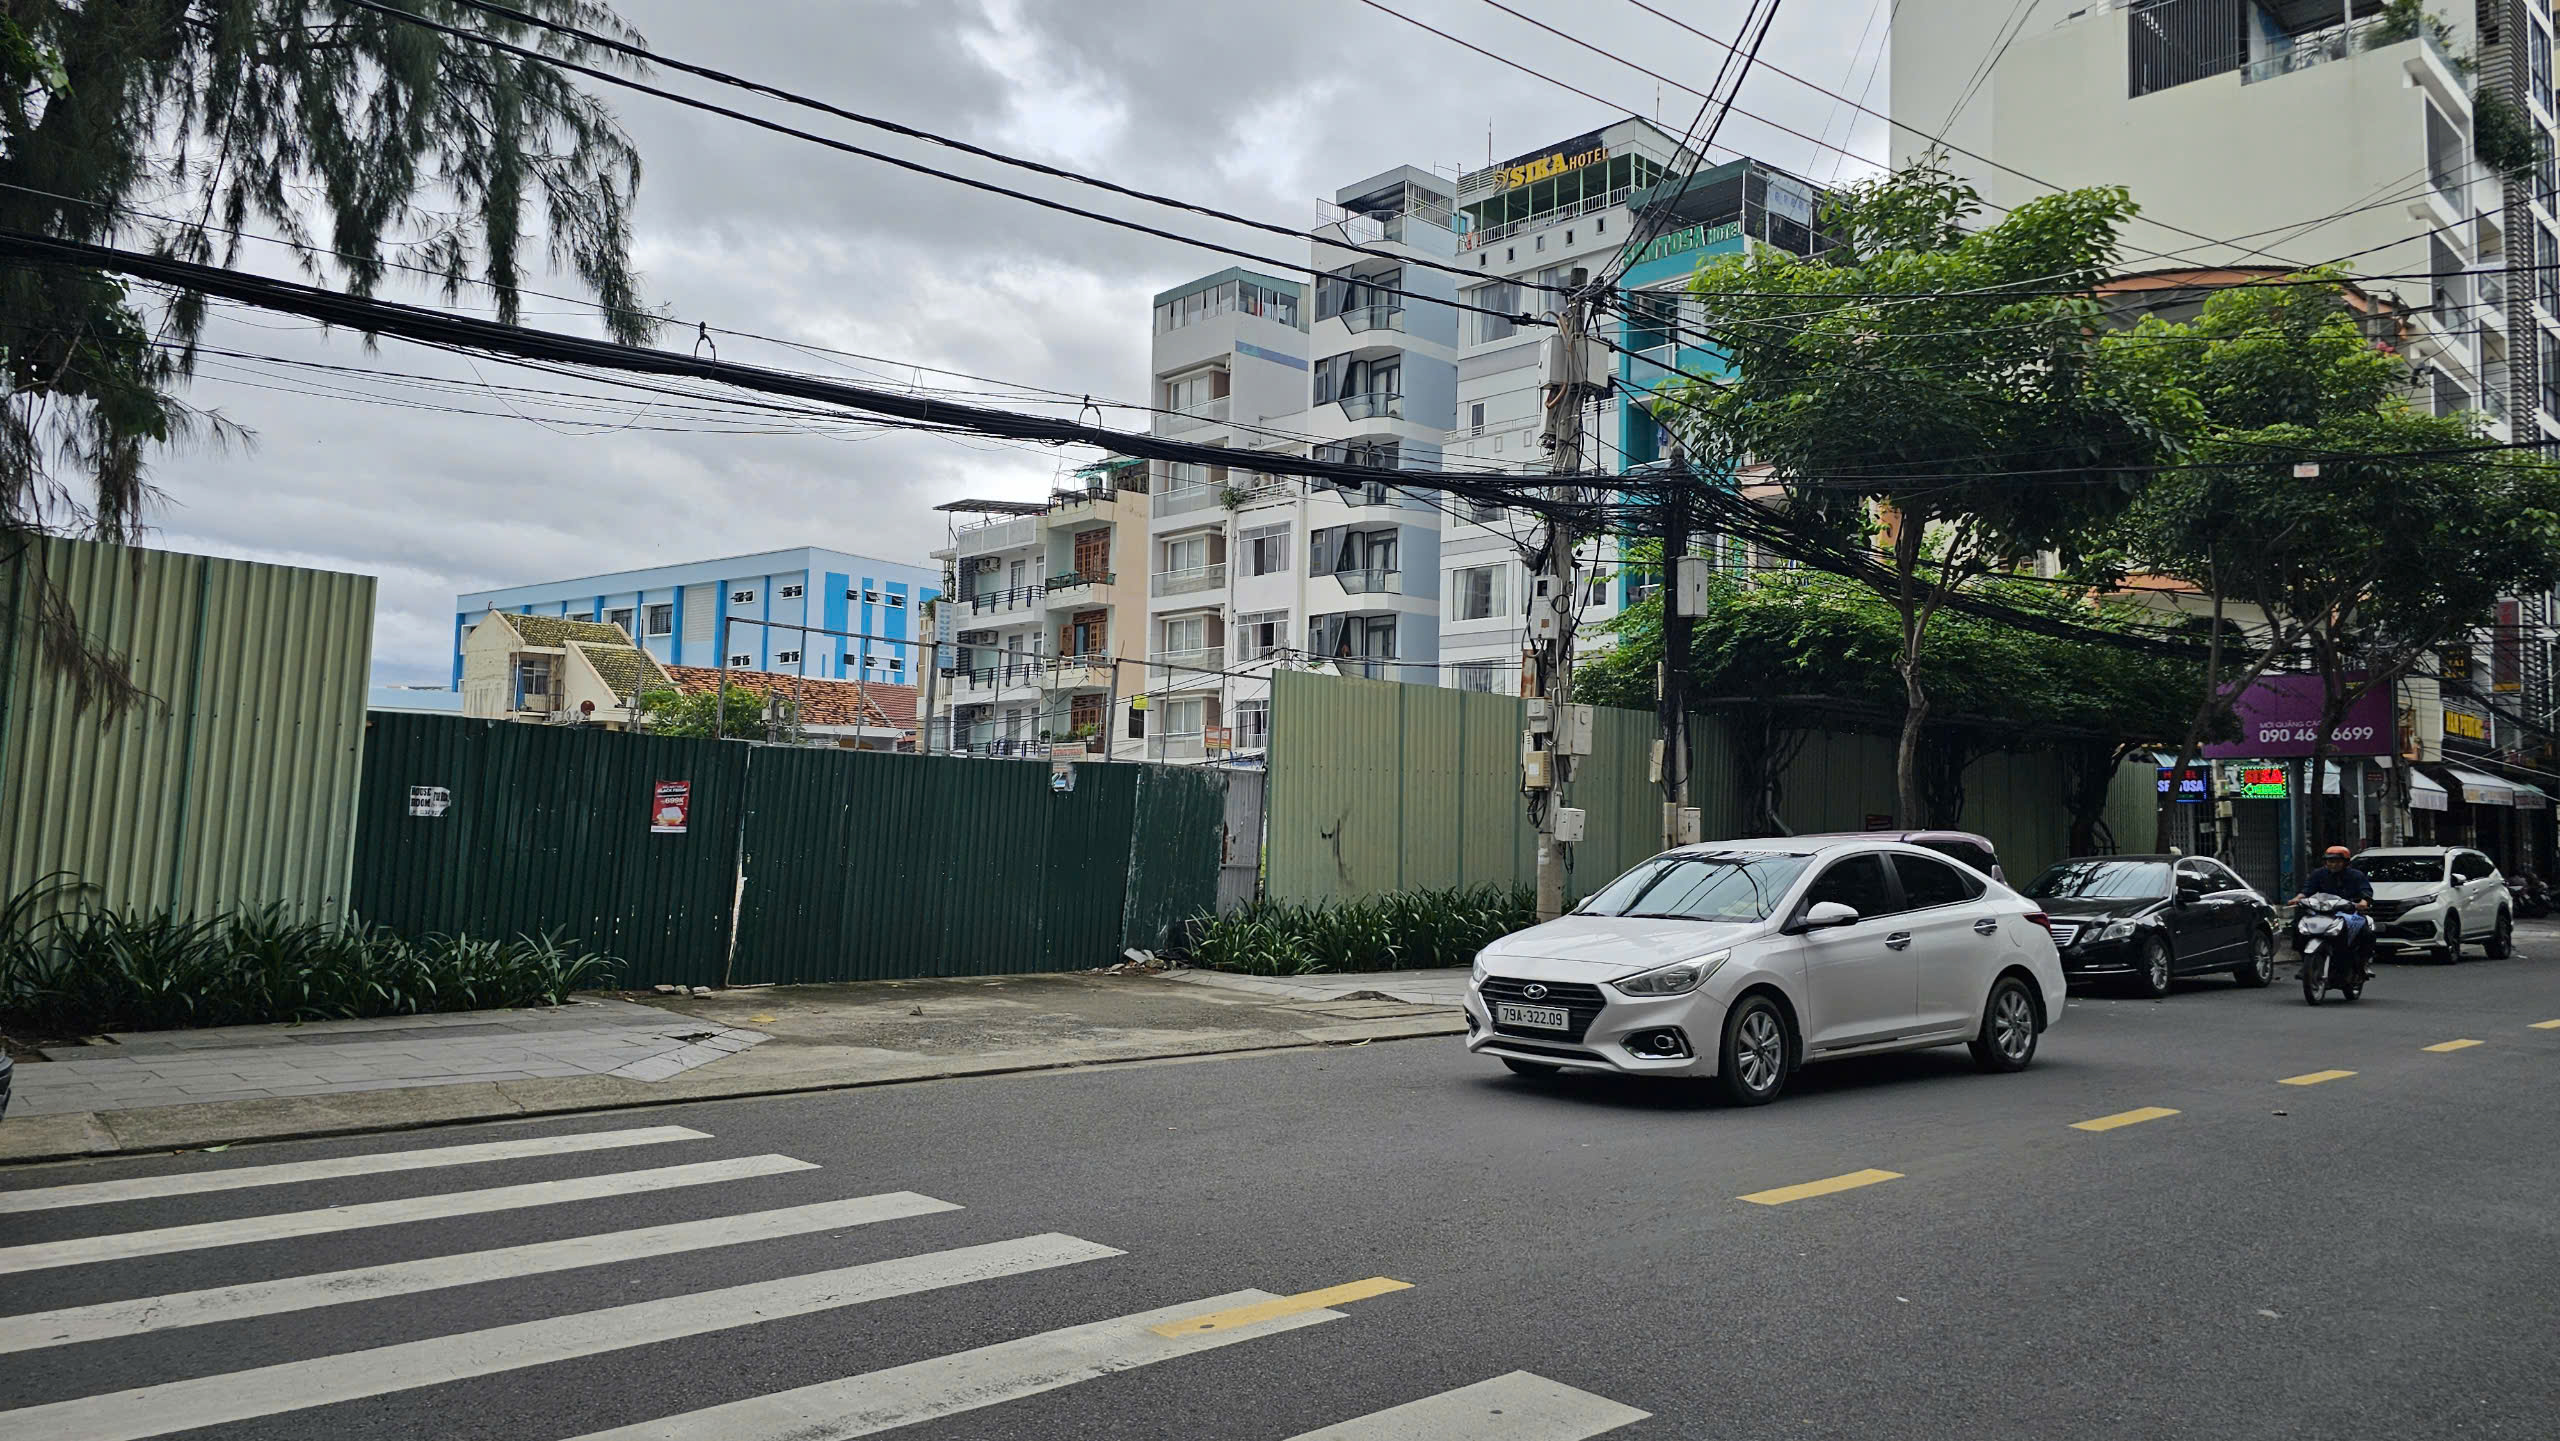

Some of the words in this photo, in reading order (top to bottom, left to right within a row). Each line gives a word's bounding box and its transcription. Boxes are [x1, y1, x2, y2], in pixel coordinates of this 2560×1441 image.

[1510, 152, 1569, 189] SIKA
[1569, 148, 1608, 170] HOTEL
[1623, 225, 1705, 268] SENTOSA
[1707, 220, 1743, 244] HOTEL
[2259, 729, 2290, 742] 090
[2294, 728, 2318, 741] 46
[2331, 727, 2374, 741] 6699
[1503, 1008, 1562, 1026] 79A-322.09
